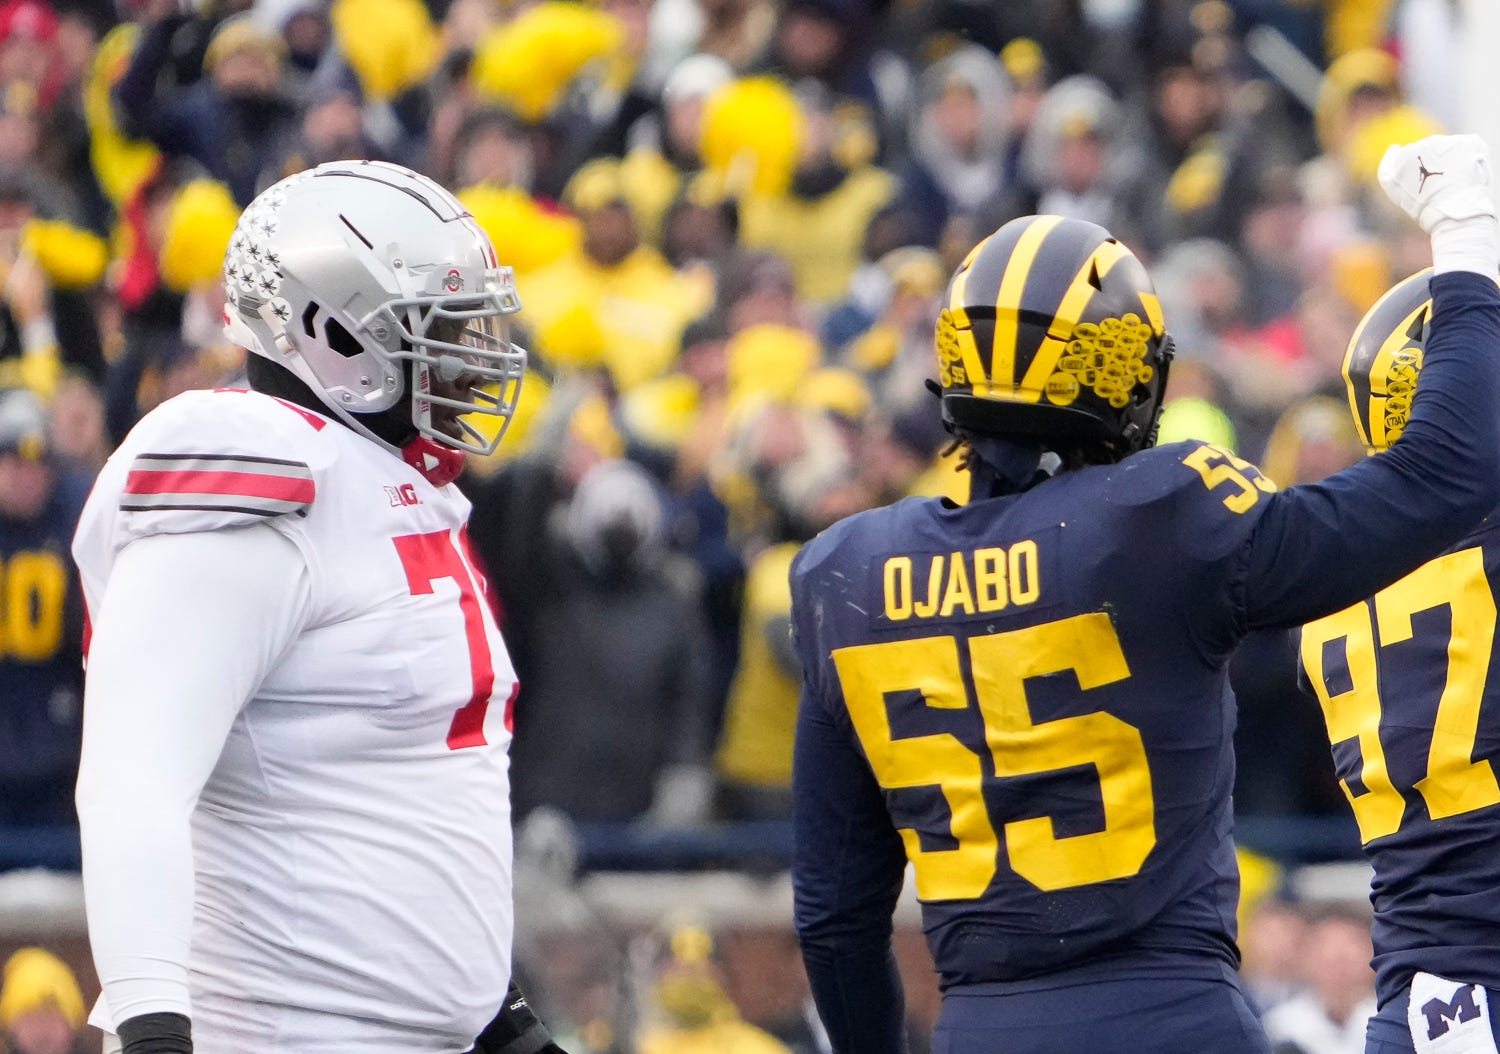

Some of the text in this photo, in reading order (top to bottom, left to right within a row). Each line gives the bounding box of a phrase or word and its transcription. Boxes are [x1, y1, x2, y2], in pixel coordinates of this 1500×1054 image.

[1182, 444, 1277, 514] 55
[884, 540, 1040, 621] OJABO
[831, 612, 1157, 900] 55
[1421, 984, 1481, 1041] M
